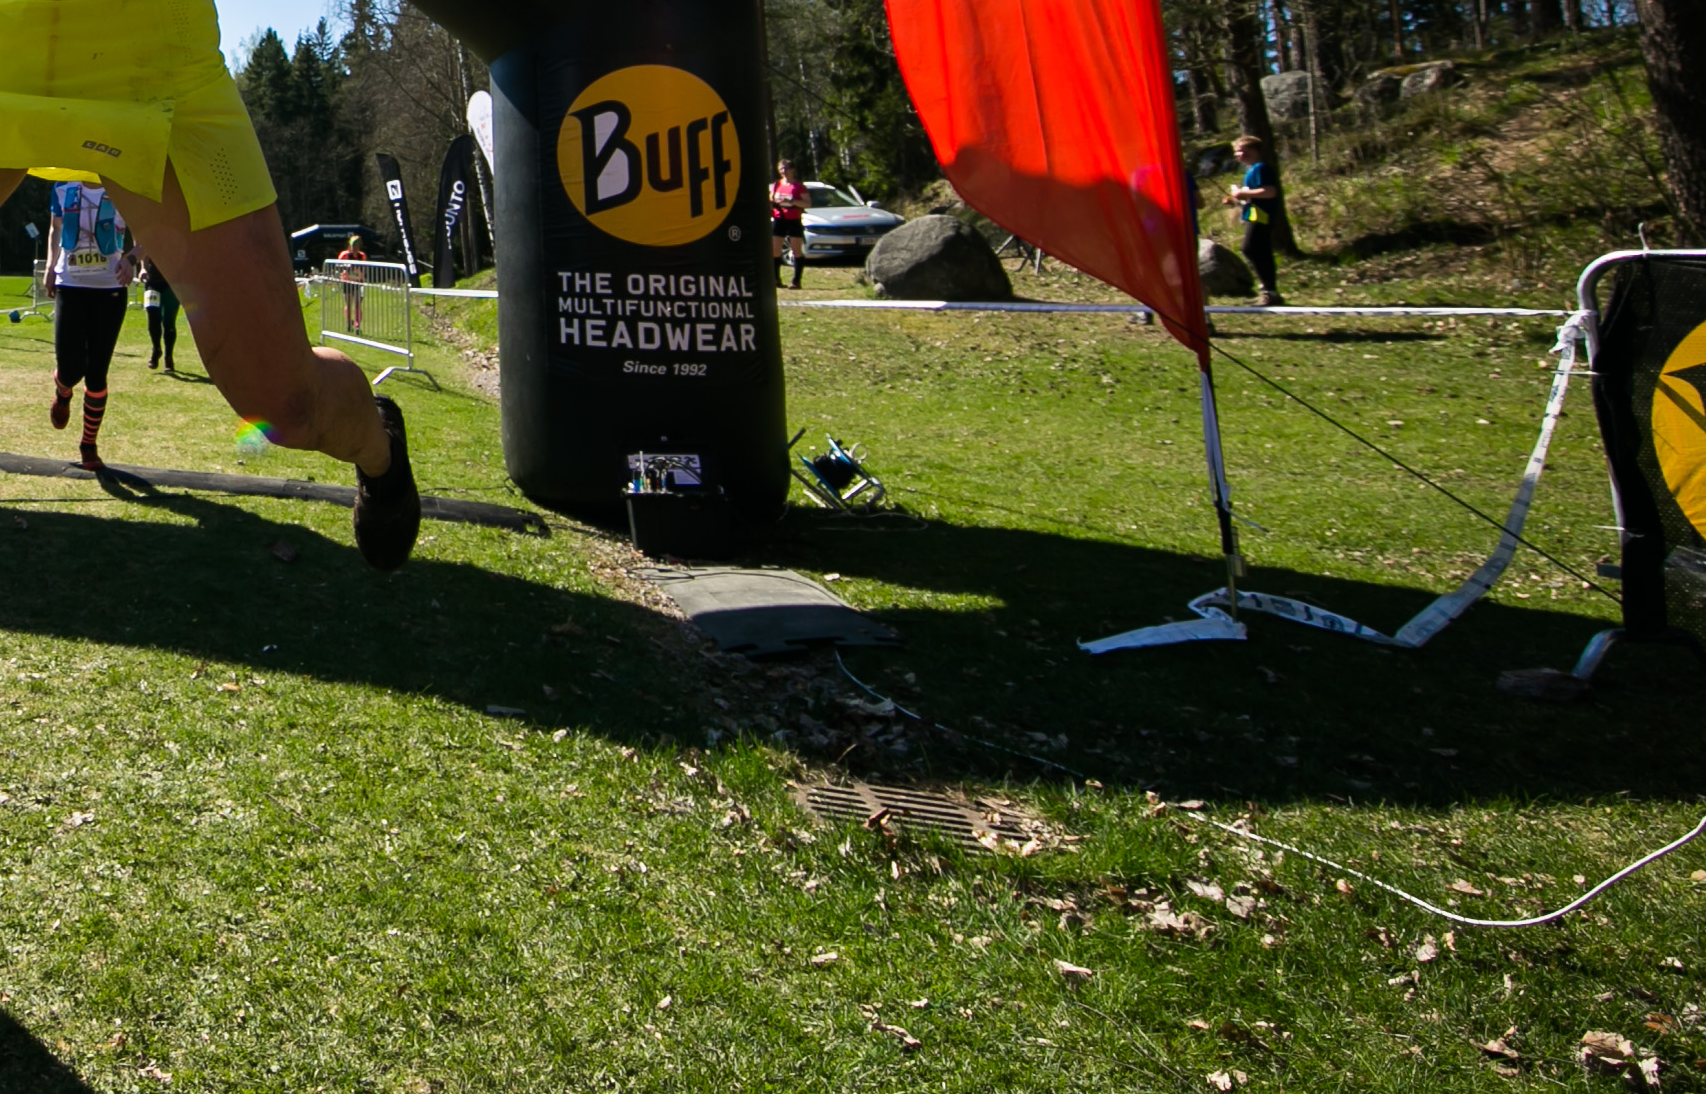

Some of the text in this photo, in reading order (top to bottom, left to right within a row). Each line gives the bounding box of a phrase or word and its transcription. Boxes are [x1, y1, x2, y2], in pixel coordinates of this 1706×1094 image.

[558, 272, 753, 297] THE ORIGINAL
[558, 297, 754, 319] MULTIFUNCTIONAL
[560, 318, 756, 352] HEADWEAR
[623, 360, 707, 377] Since 1992
